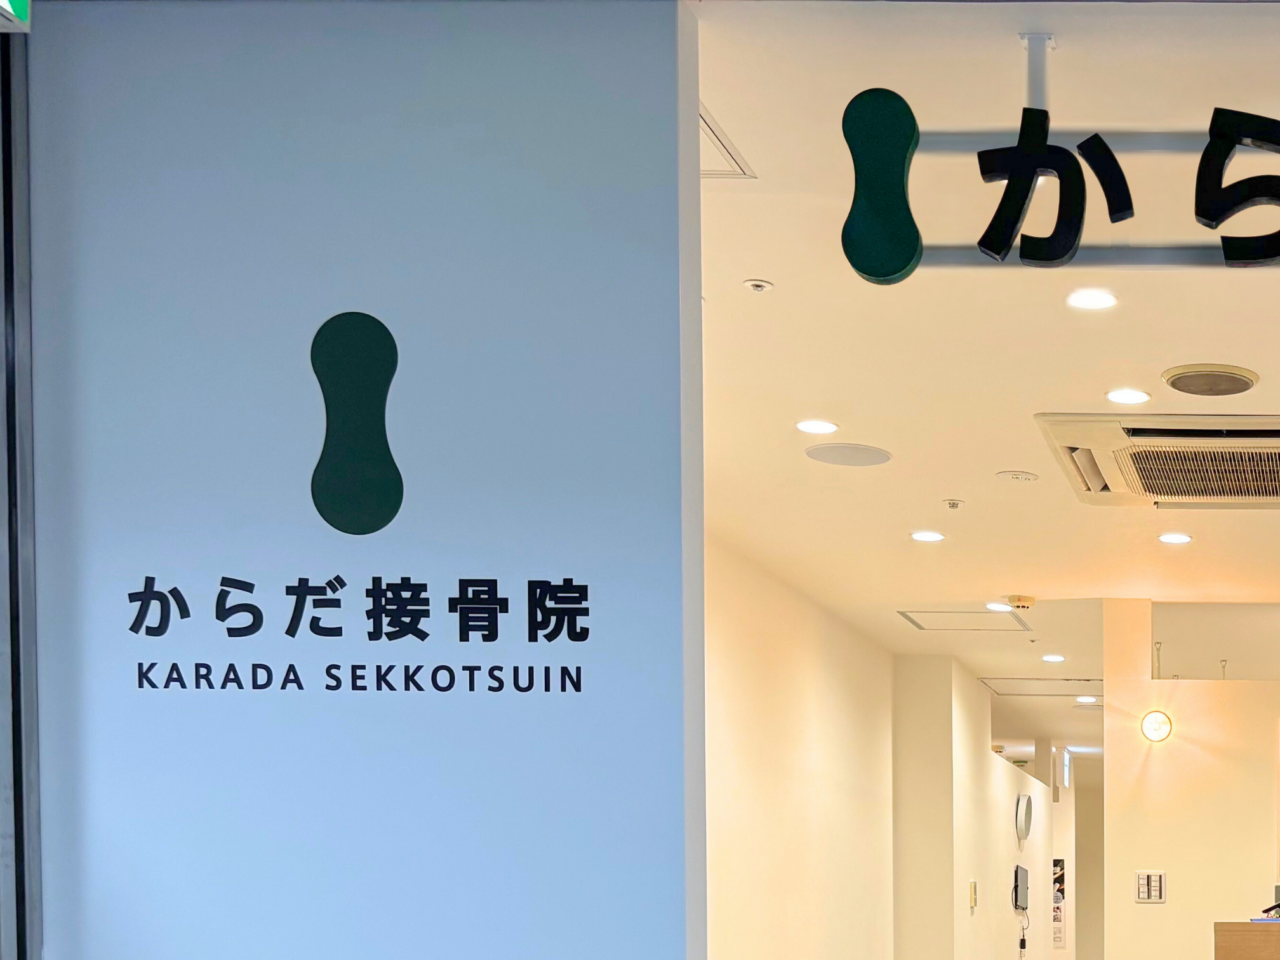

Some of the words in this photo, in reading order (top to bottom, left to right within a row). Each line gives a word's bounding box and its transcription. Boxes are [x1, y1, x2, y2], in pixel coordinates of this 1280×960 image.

[127, 574, 590, 643] からだ接骨院
[137, 662, 304, 690] KARADA
[325, 663, 582, 693] SEKKOTSUIN
